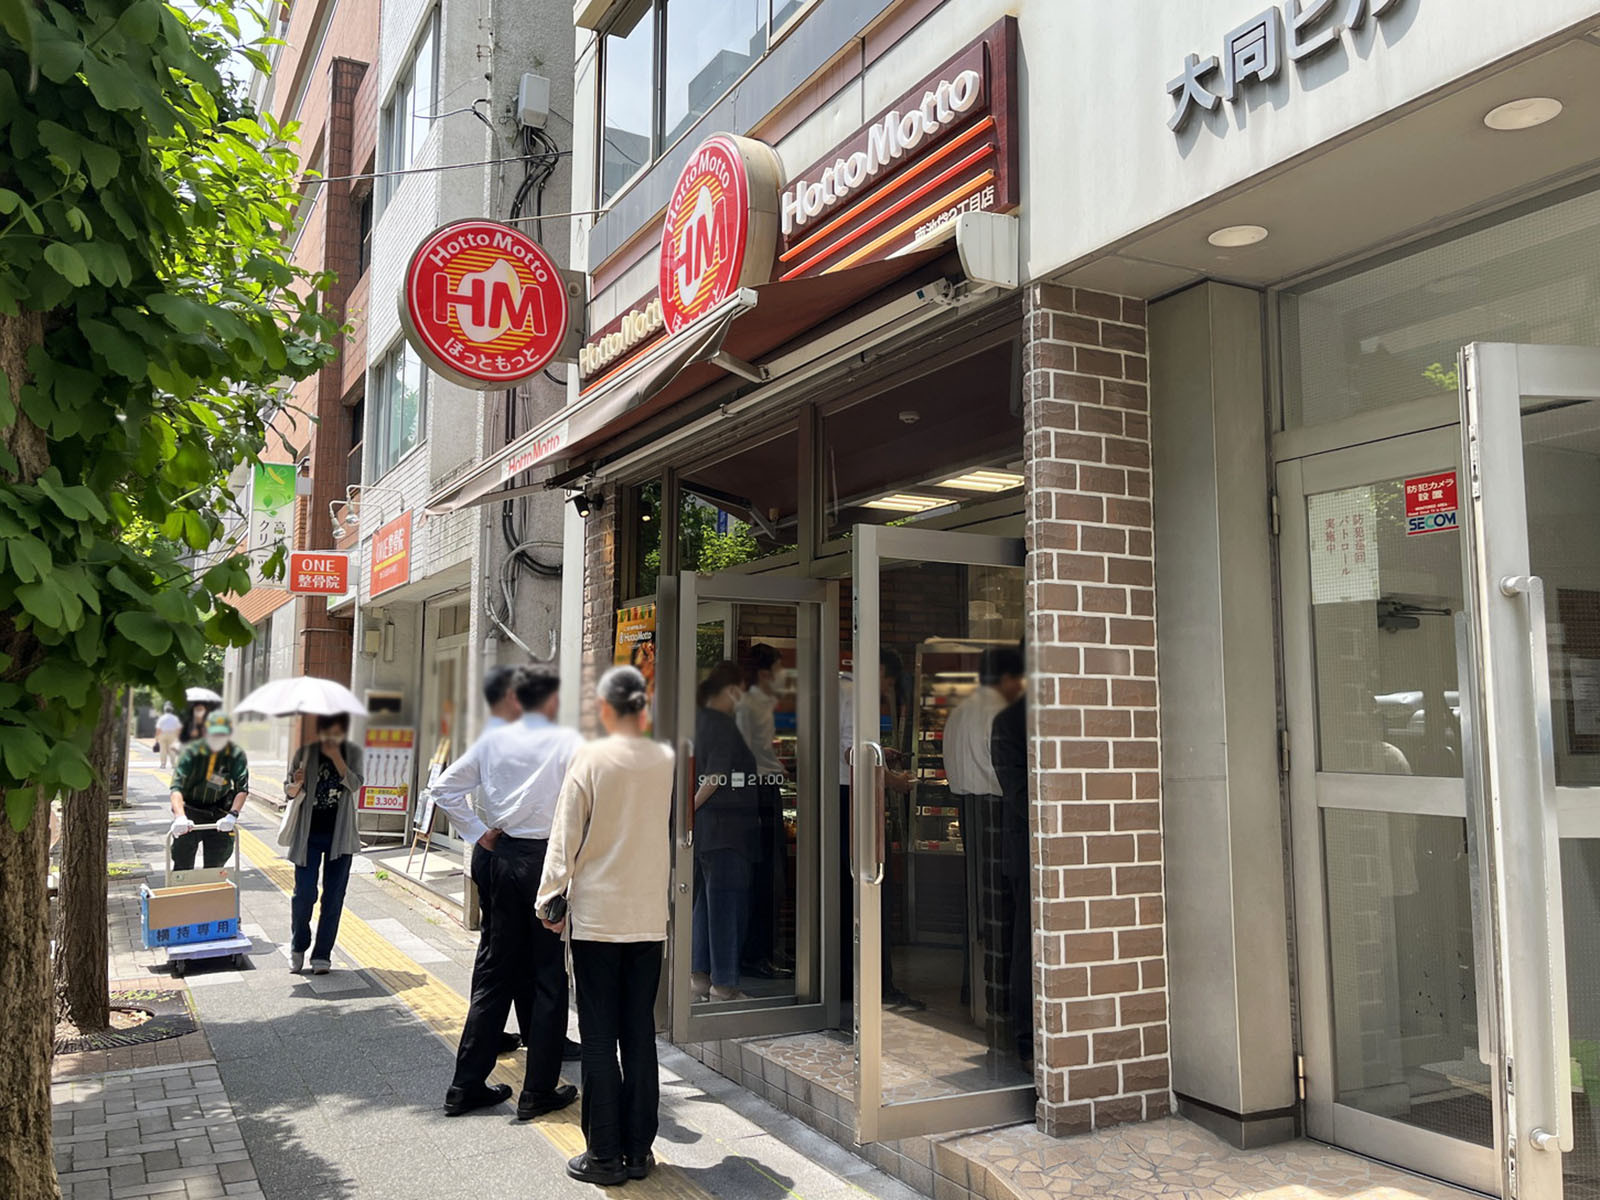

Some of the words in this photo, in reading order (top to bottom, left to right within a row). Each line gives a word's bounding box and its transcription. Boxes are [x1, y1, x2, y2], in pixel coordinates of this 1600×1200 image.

[1166, 0, 1400, 132] 大同ビ
[579, 297, 664, 379] HottoMott
[443, 337, 541, 372] ほっともっと
[1407, 478, 1454, 494] 防犯カメラ
[1418, 490, 1443, 501] 設置
[1409, 512, 1456, 531] SECOM
[1340, 515, 1351, 576] パトロール
[302, 558, 336, 572] ONE
[298, 574, 340, 589] 整骨院
[698, 774, 727, 786] 9:00
[748, 774, 784, 786] 21:00
[156, 921, 229, 942] 横持専用
